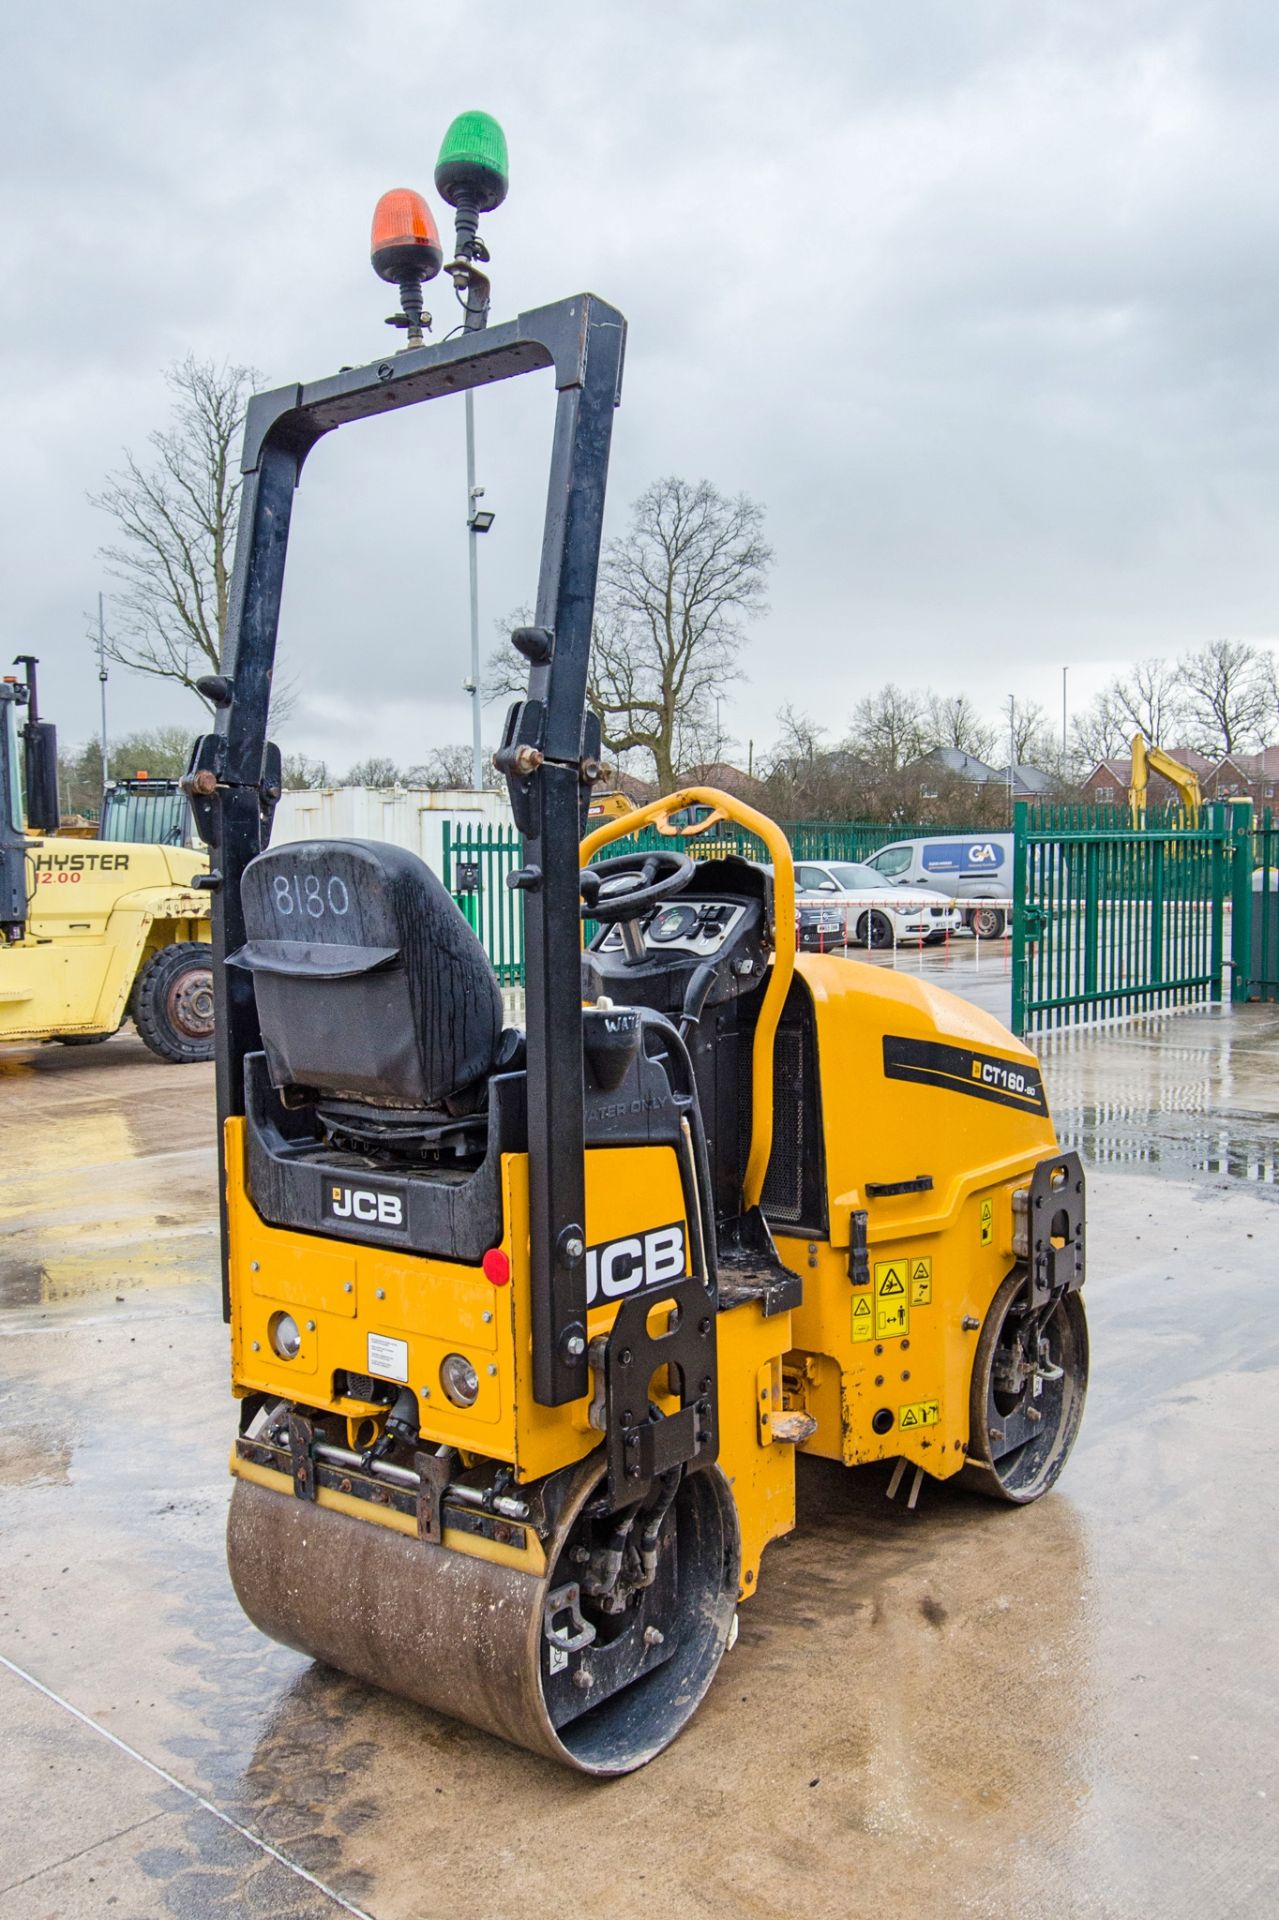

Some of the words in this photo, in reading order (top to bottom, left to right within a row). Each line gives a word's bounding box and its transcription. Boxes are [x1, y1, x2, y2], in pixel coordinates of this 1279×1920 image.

[36, 854, 129, 871] HYSTER
[273, 875, 349, 918] 8180
[584, 1104, 626, 1121] ATER
[630, 1095, 668, 1113] ONLY
[332, 1187, 402, 1225] JCB
